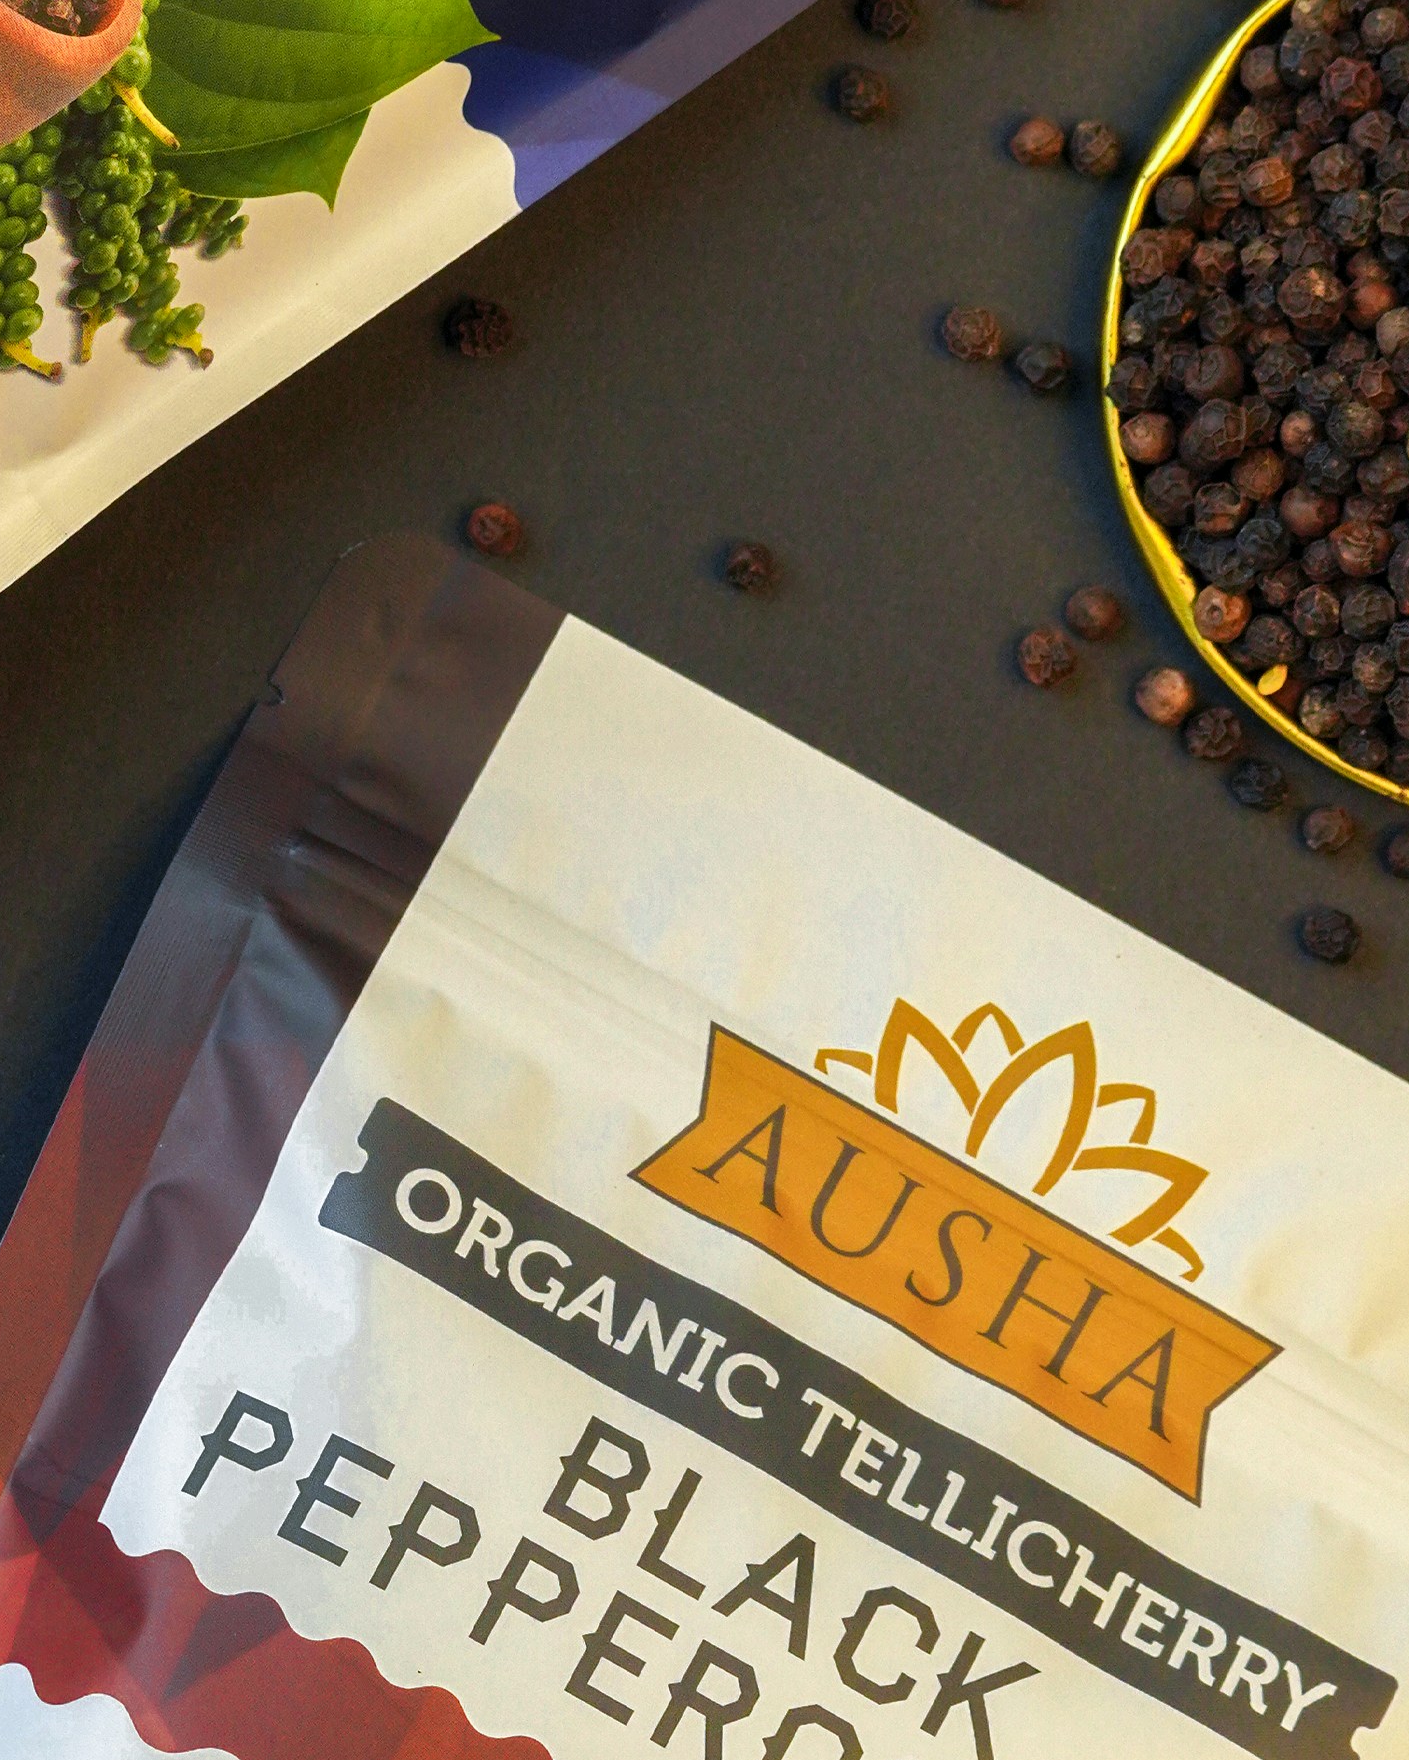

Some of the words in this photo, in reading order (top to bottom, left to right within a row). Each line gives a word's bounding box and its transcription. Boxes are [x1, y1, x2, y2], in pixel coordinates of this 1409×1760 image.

[393, 1166, 781, 1422] ORGANIC
[799, 1395, 1340, 1735] TELLICHERRY
[695, 1103, 1178, 1443] AUSHA
